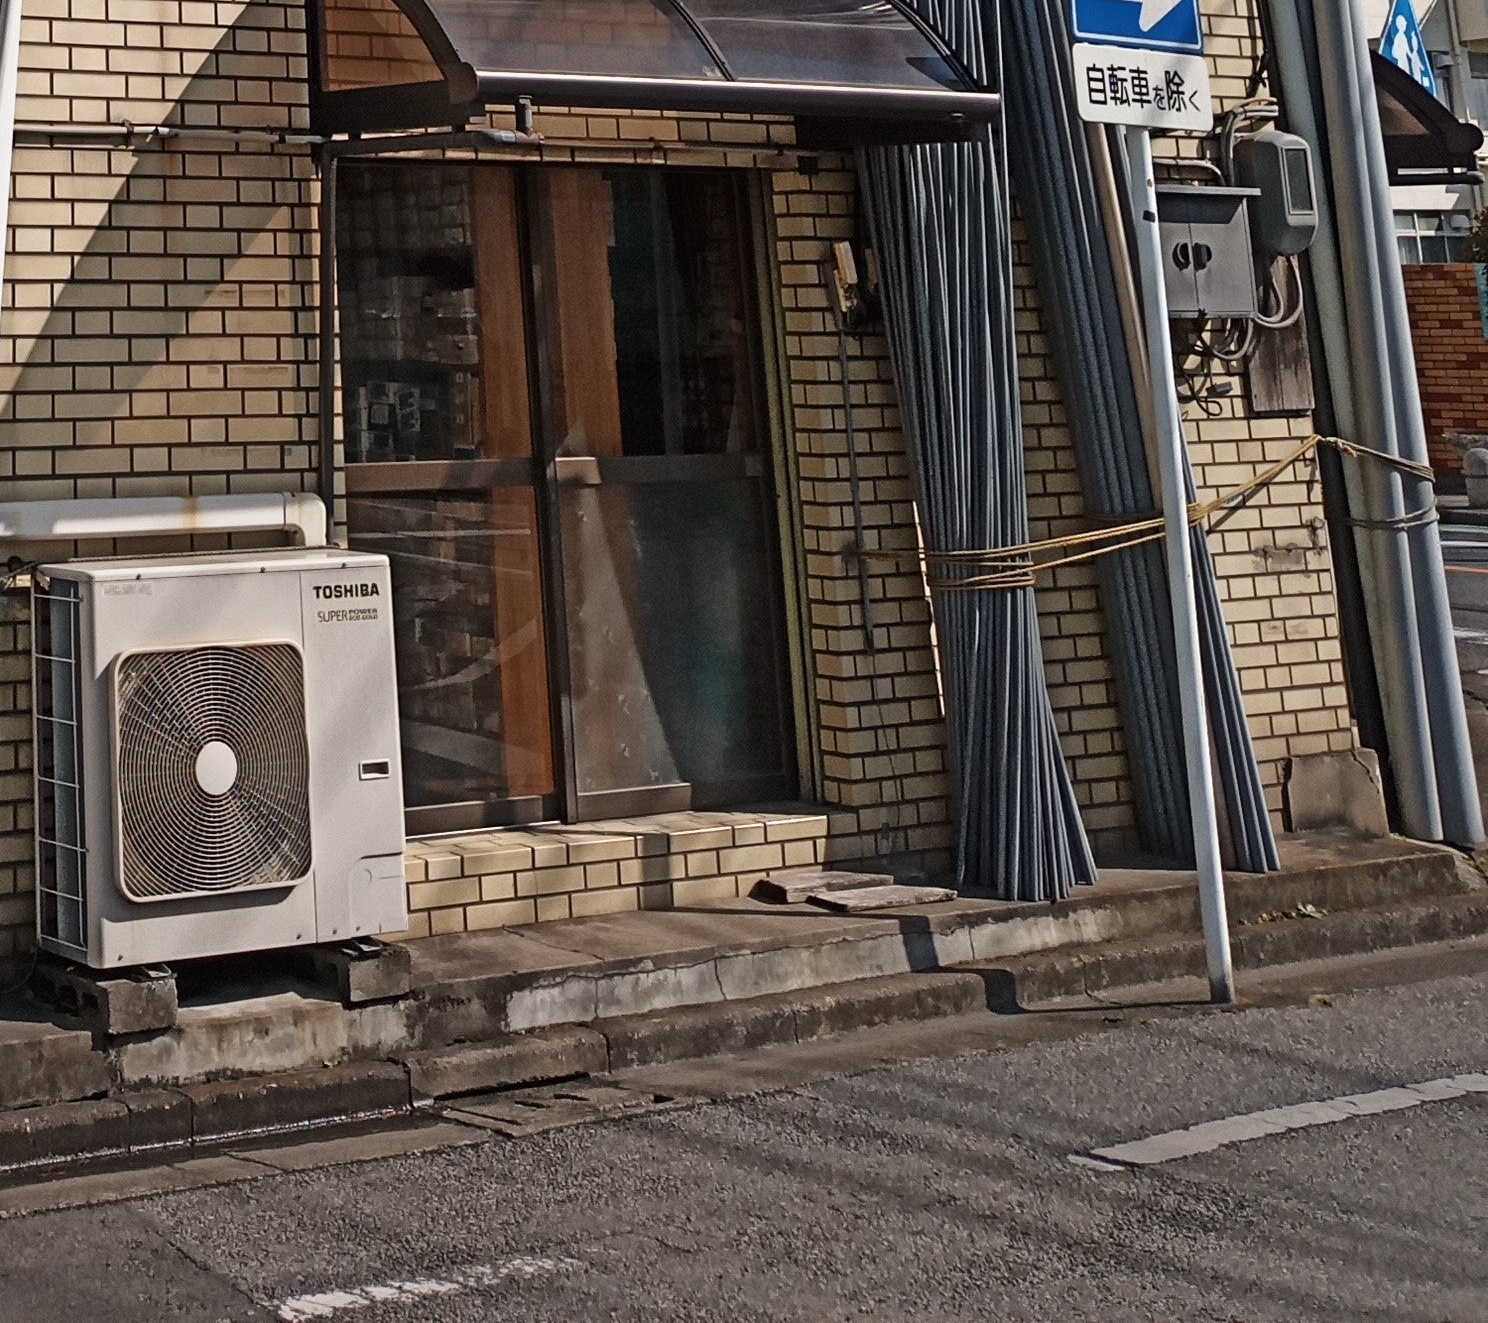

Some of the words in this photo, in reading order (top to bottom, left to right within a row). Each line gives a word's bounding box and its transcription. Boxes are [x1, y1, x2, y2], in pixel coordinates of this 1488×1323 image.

[1086, 63, 1201, 113] 自転車を除く
[312, 582, 380, 599] TOSHIBA
[317, 609, 348, 623] SUPER
